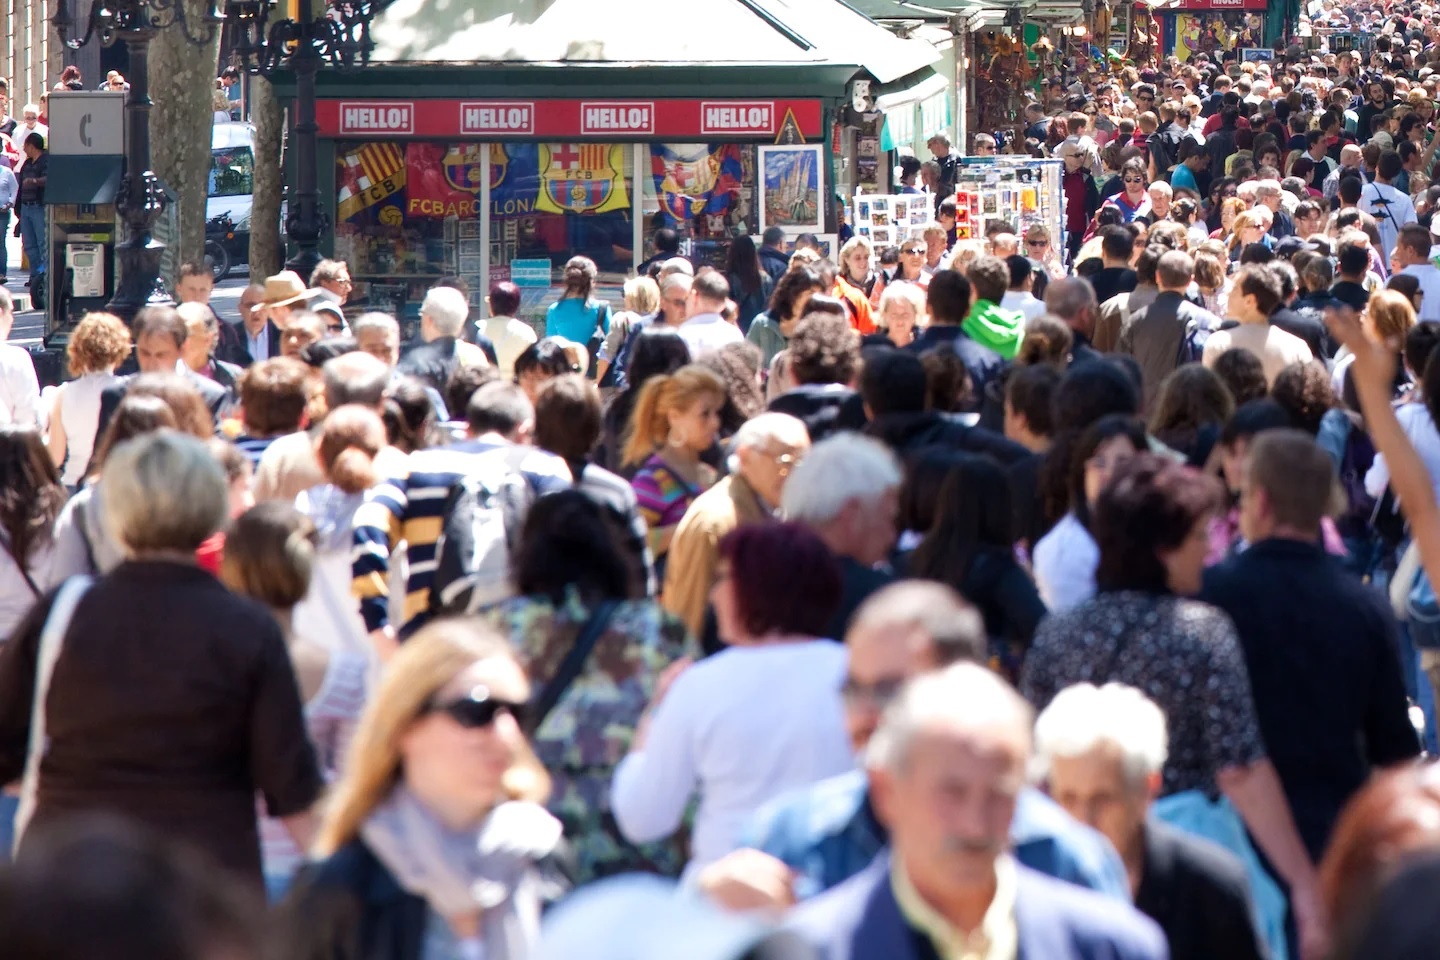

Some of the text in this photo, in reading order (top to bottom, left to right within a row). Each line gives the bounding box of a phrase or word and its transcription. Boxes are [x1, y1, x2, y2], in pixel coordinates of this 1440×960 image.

[345, 108, 768, 129] HELLO! HELLO! HELLO! HELLO!
[566, 169, 593, 180] FCB
[409, 197, 536, 216] FCBARCLON
